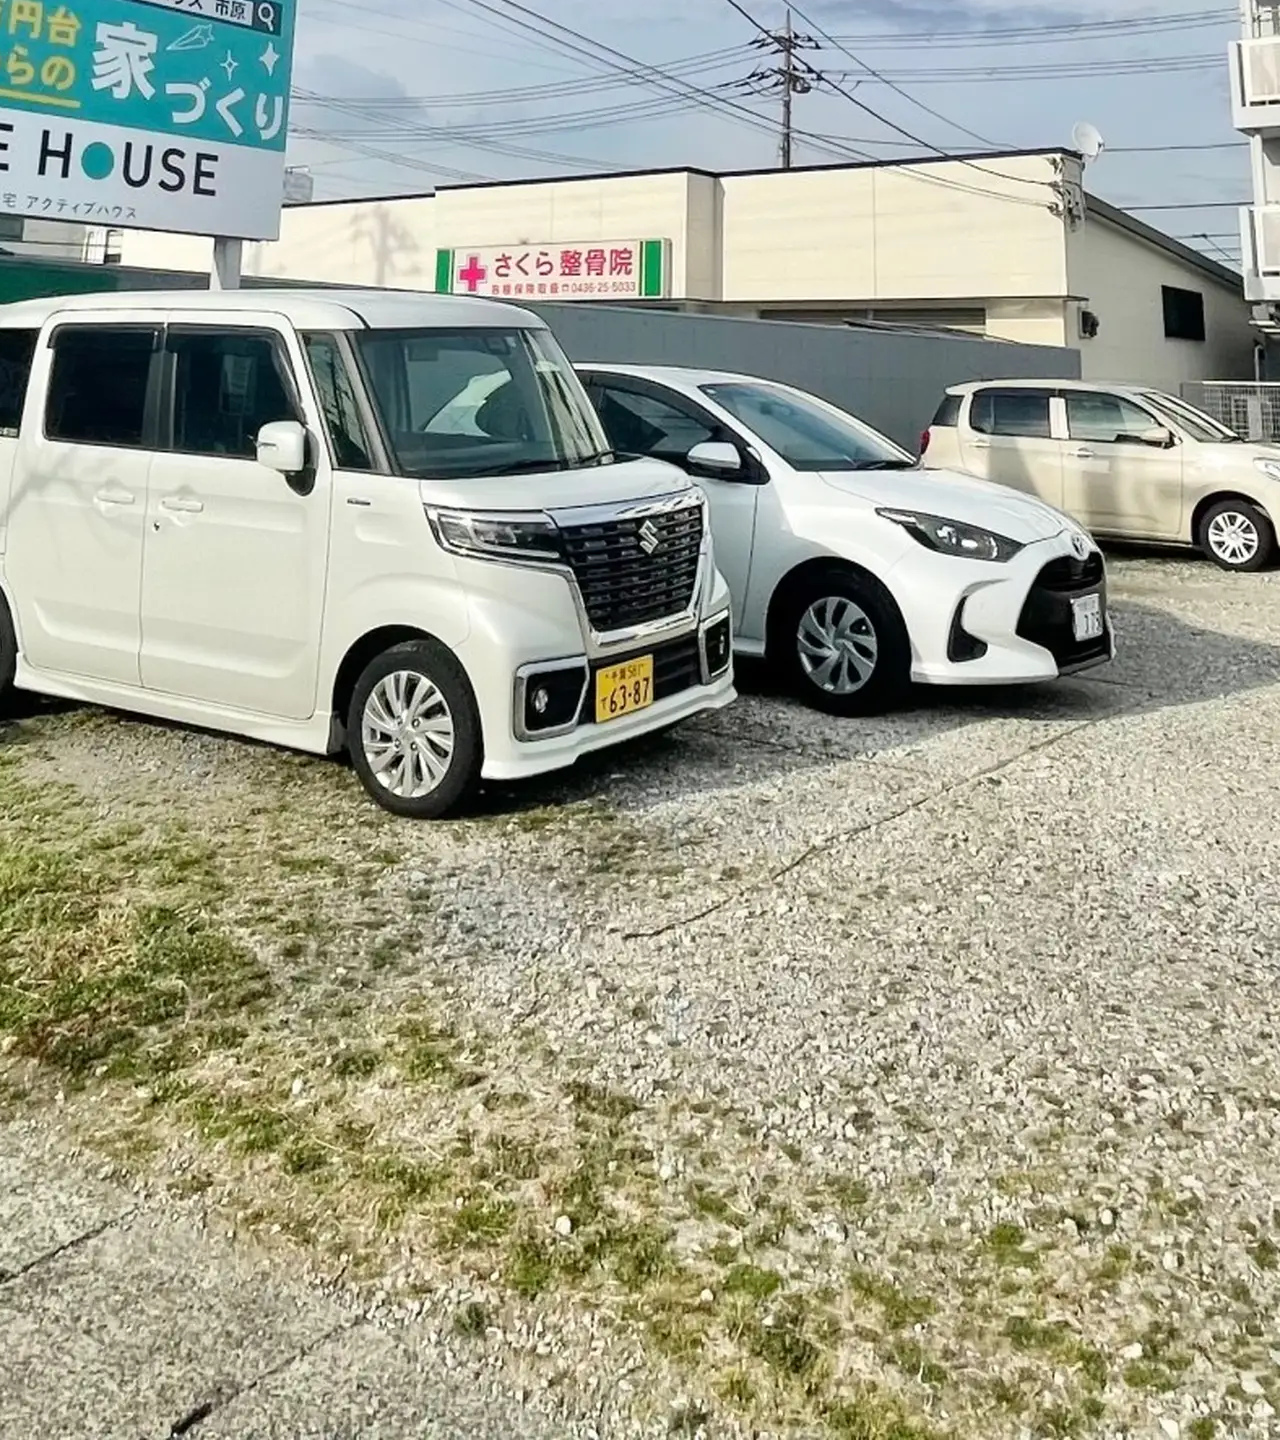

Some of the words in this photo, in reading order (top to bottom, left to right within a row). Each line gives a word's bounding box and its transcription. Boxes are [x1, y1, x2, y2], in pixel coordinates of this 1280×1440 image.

[37, 128, 220, 197] HOUSE
[25, 194, 137, 220] アクティブハウス
[494, 247, 634, 278] さくら整骨院
